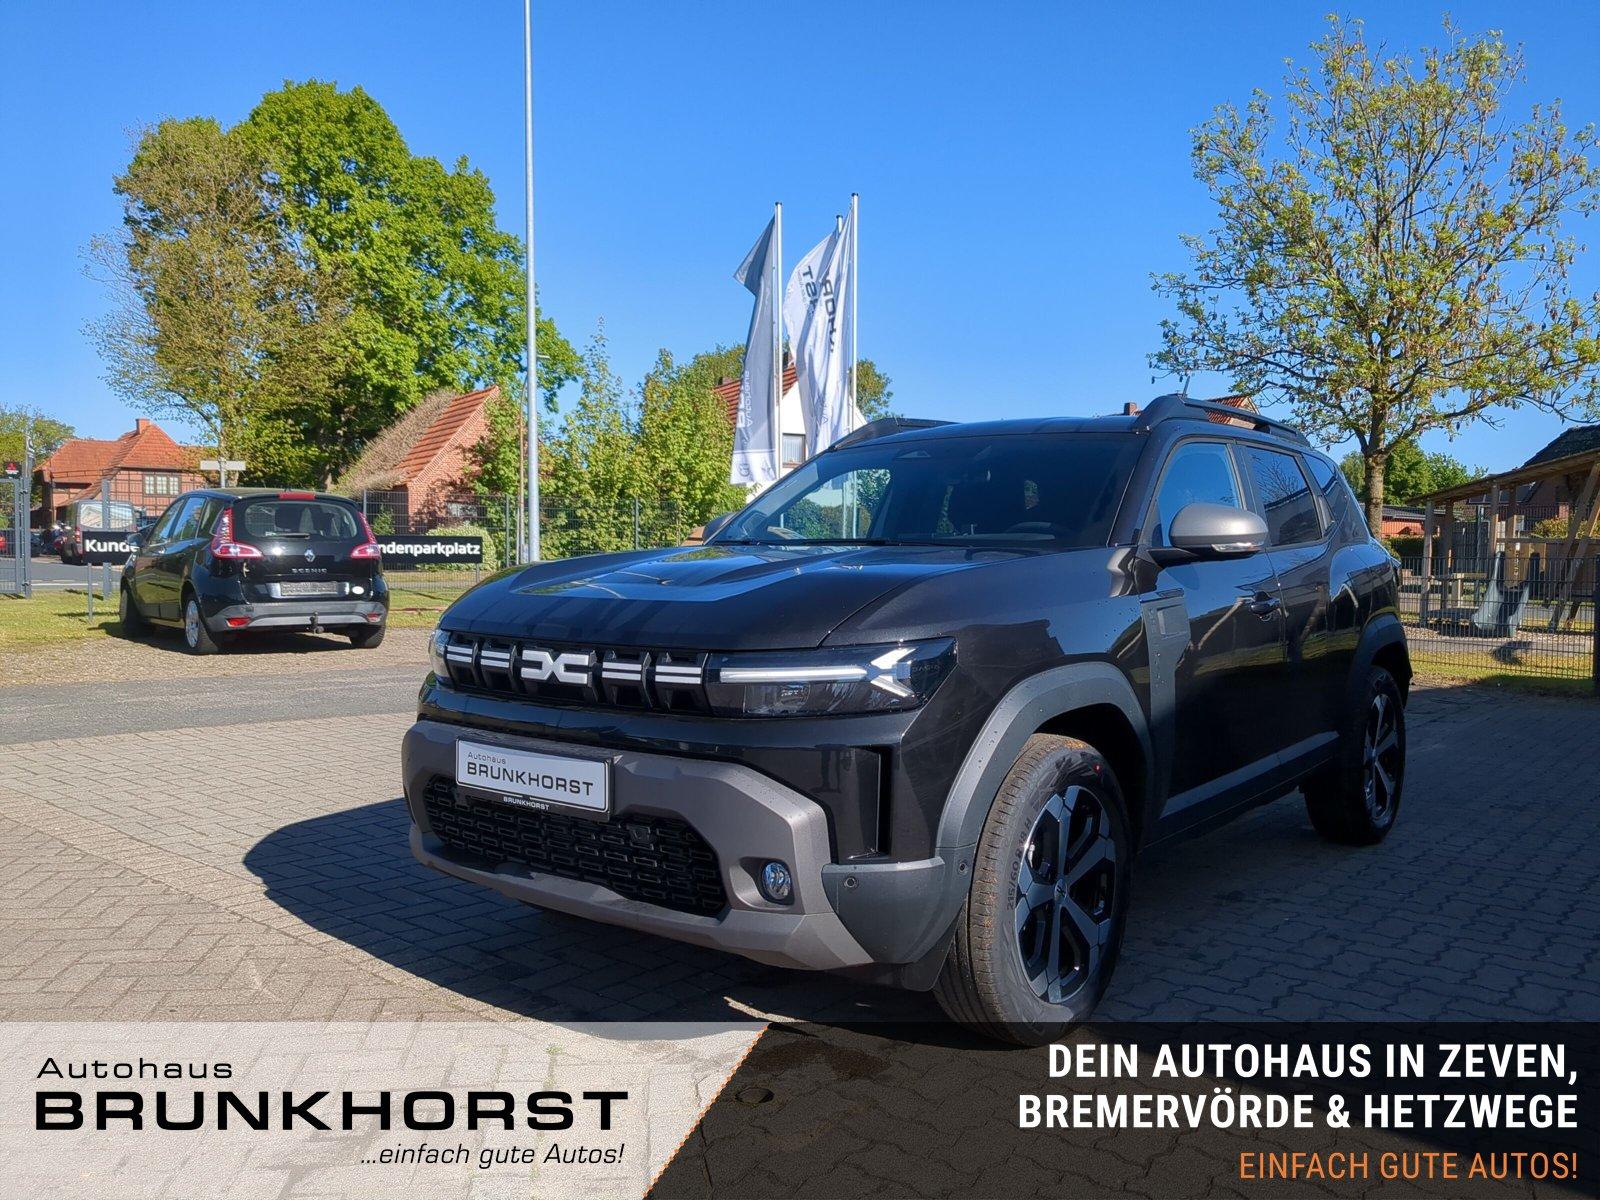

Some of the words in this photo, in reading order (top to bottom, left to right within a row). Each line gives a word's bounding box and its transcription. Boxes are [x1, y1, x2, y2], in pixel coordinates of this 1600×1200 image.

[467, 751, 507, 764] Autohaus
[467, 762, 594, 796] BRUNKHORST
[503, 796, 550, 811] BRUNKHORST
